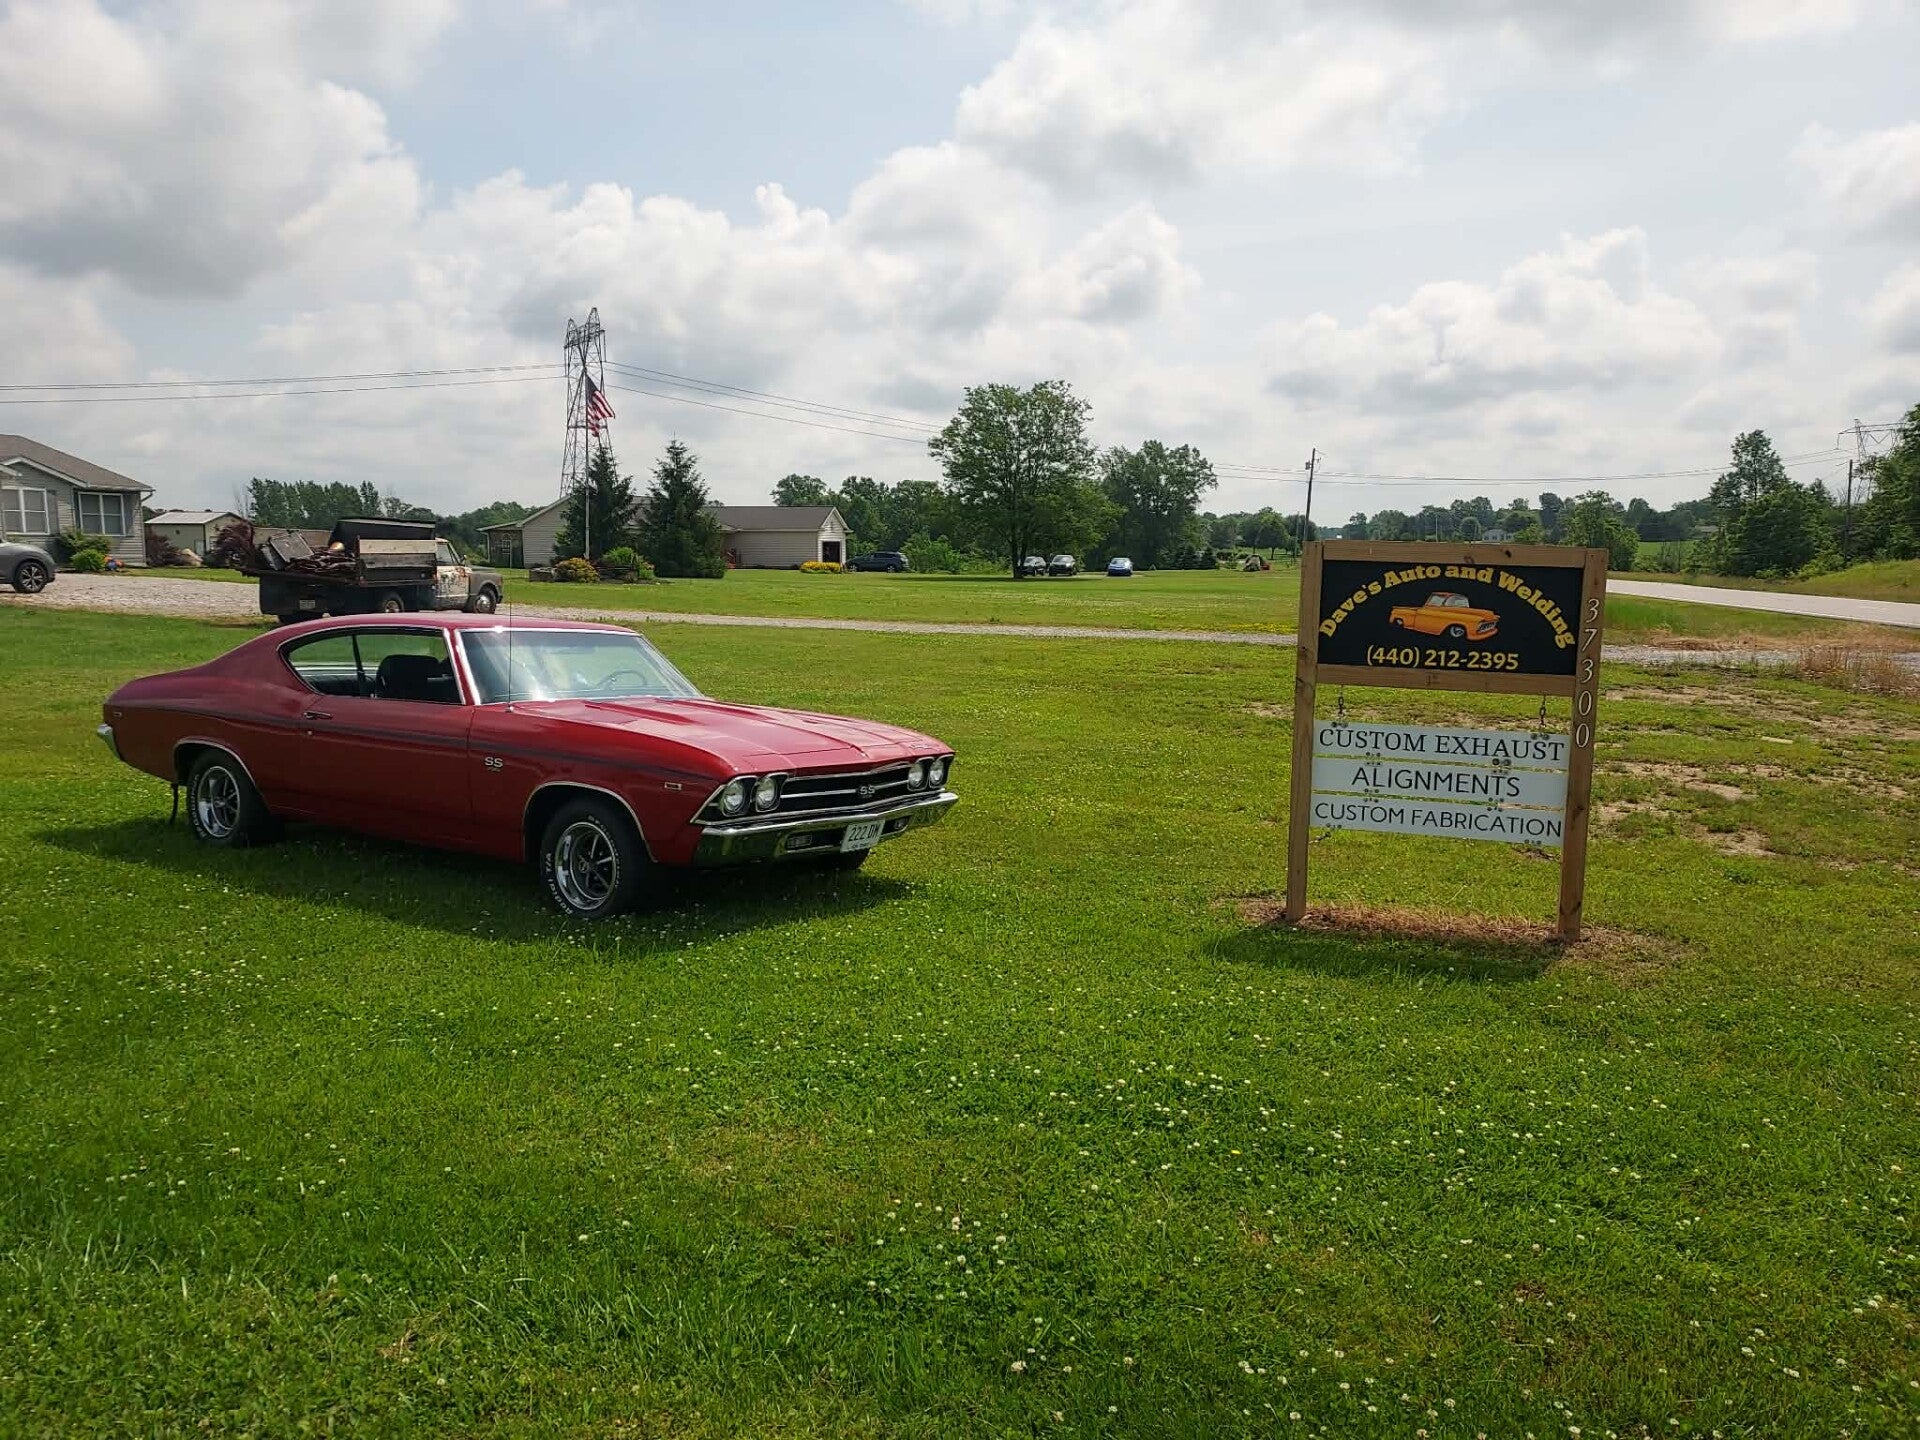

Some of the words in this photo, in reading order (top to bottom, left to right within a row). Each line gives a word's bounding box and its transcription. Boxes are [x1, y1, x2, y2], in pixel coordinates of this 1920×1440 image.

[1319, 578, 1382, 638] Dave's
[1383, 564, 1441, 589] Auto
[1444, 565, 1494, 584] and
[1497, 571, 1576, 649] Welding
[1366, 644, 1420, 669] (440)
[1424, 650, 1519, 671] 212-2395
[1319, 728, 1427, 753] CUSTOM
[1434, 735, 1565, 761] EXHAUST
[484, 756, 504, 768] SS
[860, 785, 876, 795] SS
[1351, 766, 1521, 797] ALIGNMENTS
[848, 826, 868, 842] 222
[1314, 802, 1405, 824] CUSTOM
[1411, 809, 1562, 838] FABRICATION
